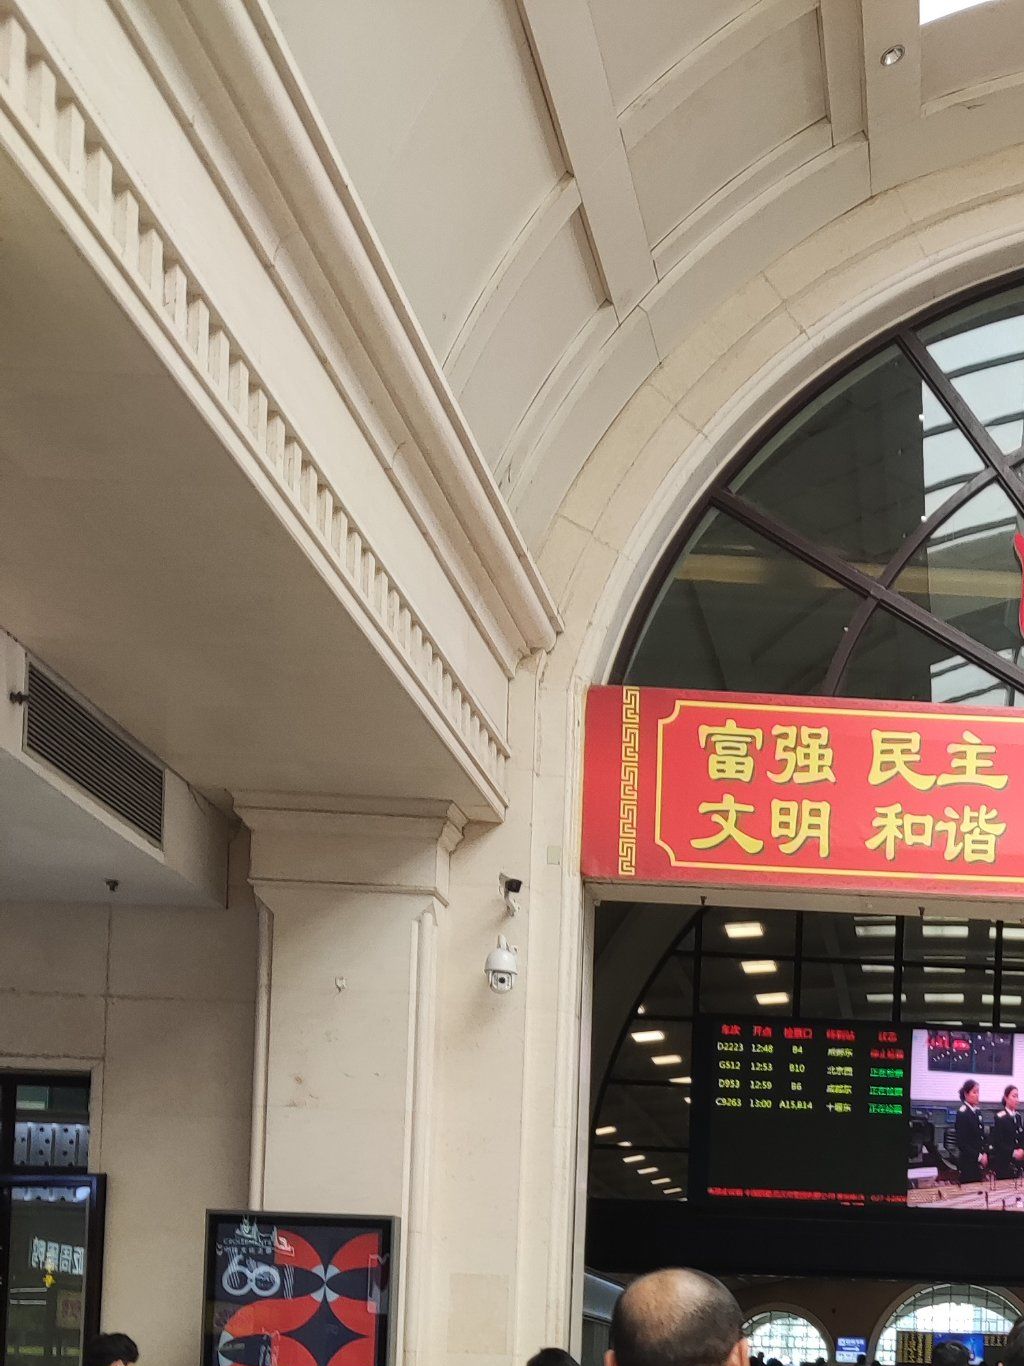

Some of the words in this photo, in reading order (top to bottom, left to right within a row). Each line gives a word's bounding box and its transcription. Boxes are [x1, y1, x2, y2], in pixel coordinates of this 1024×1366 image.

[701, 720, 834, 784] 富强
[869, 731, 1008, 791] 民主
[693, 796, 830, 857] 文明
[867, 804, 1005, 862] 和谐
[718, 1043, 743, 1051] D2223
[752, 1044, 773, 1052] 12:48
[719, 1061, 740, 1069] G512
[751, 1063, 772, 1071] 12:53
[789, 1064, 805, 1072] B10
[719, 1079, 740, 1088] D953
[751, 1081, 772, 1089] 12:59
[750, 1099, 772, 1108] 13:00
